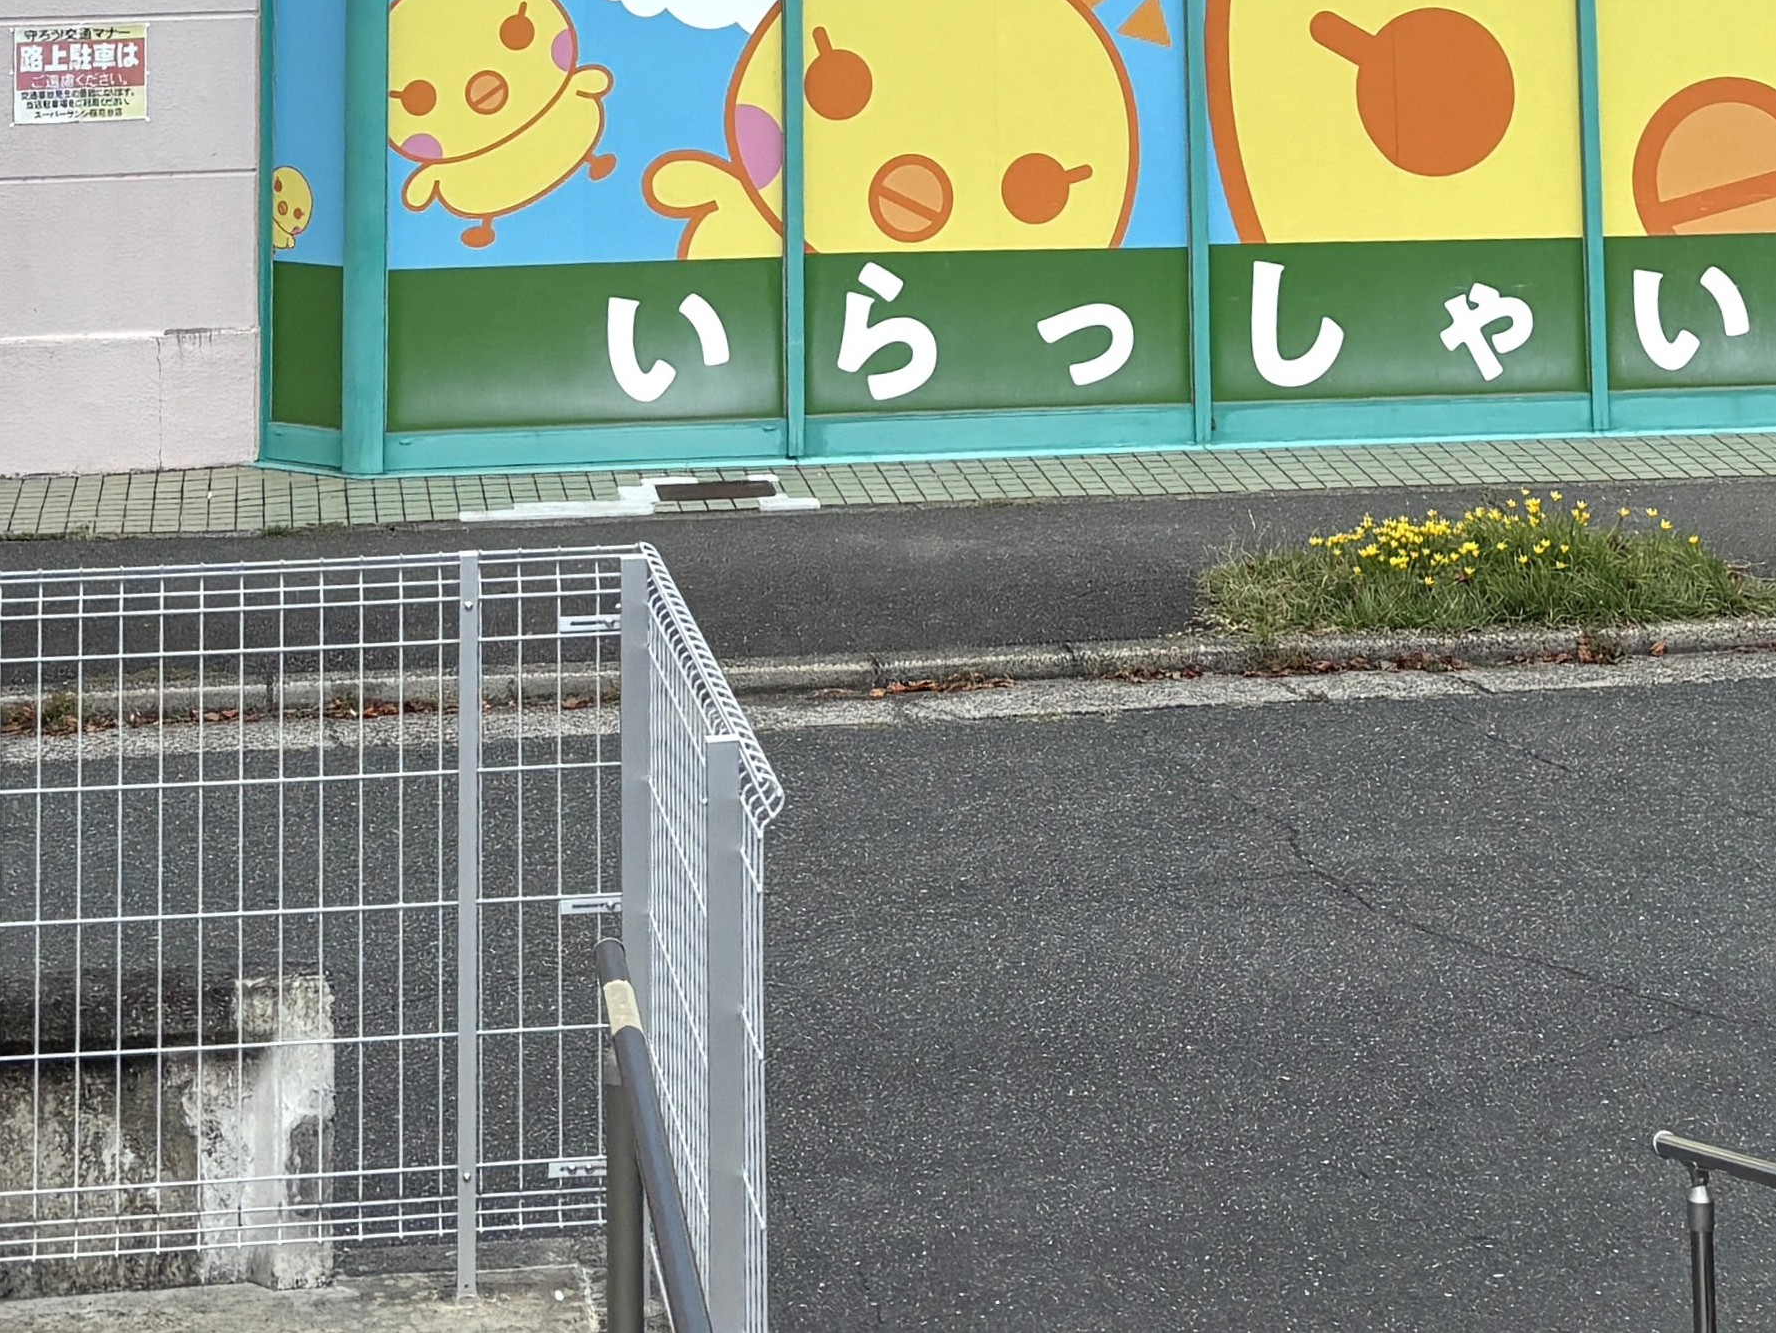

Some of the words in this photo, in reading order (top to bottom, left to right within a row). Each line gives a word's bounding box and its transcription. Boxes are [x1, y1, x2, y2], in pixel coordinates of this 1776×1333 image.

[20, 42, 140, 73] 路上駐車は
